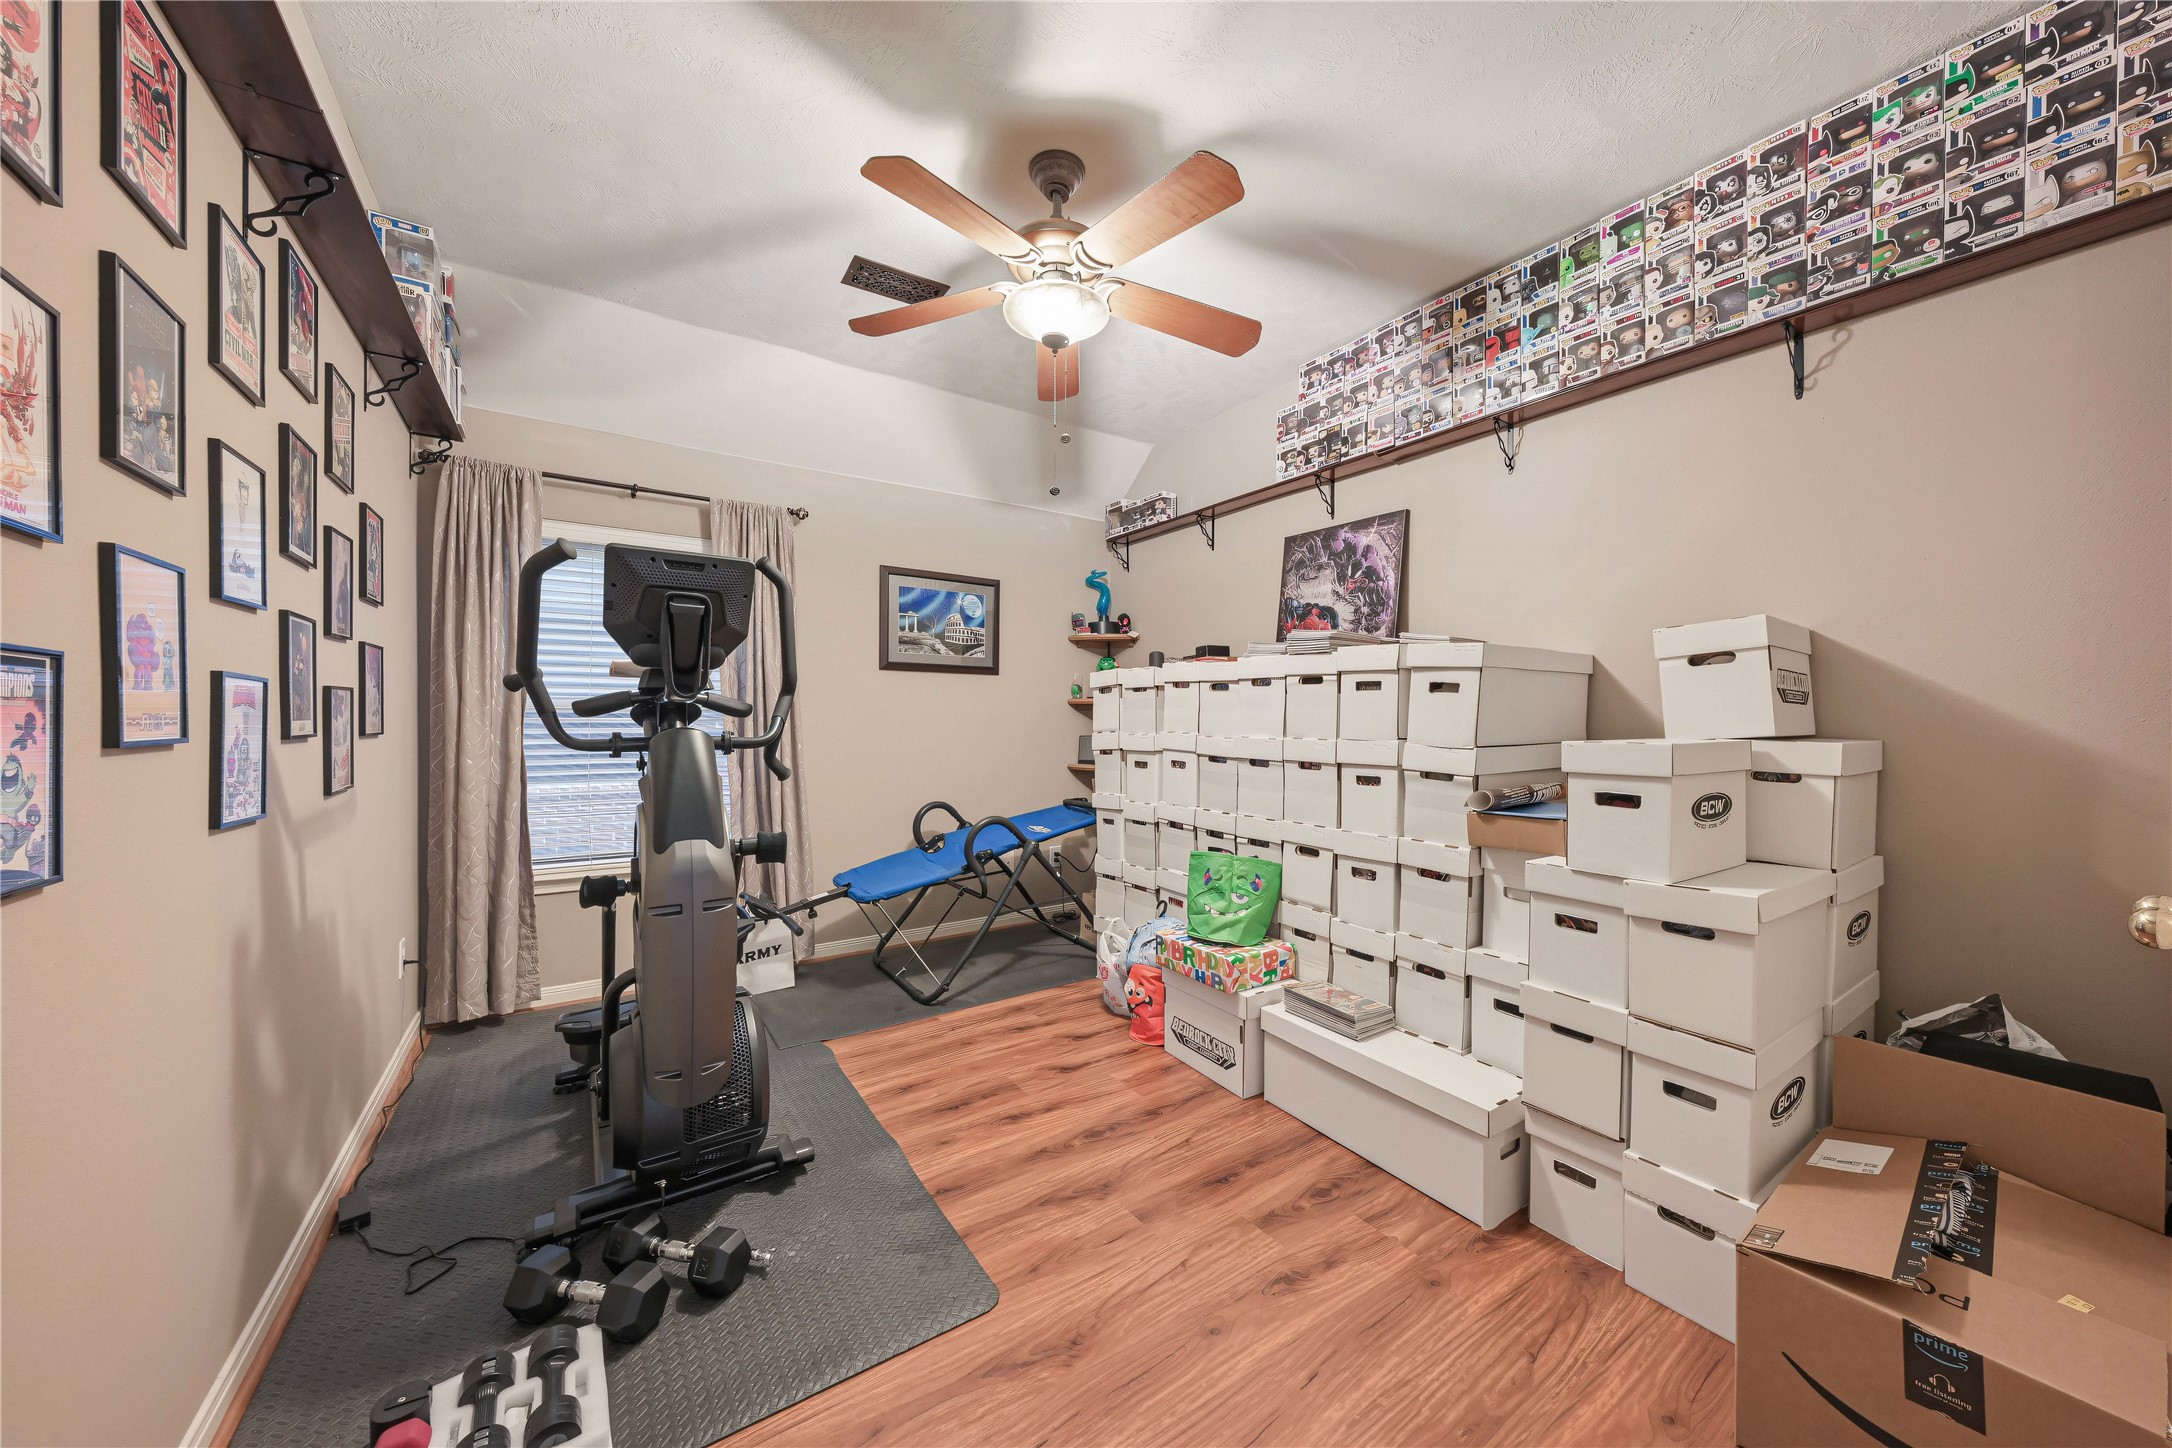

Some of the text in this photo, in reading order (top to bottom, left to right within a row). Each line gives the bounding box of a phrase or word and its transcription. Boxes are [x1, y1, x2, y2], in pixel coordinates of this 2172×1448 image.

[1700, 799, 1725, 815] BCW
[1852, 916, 1868, 935] BCW
[1171, 1016, 1212, 1052] BEDROCK
[1777, 1081, 1801, 1114] BCW
[1913, 1331, 1969, 1362] prime
[1933, 1387, 1973, 1411] listening
